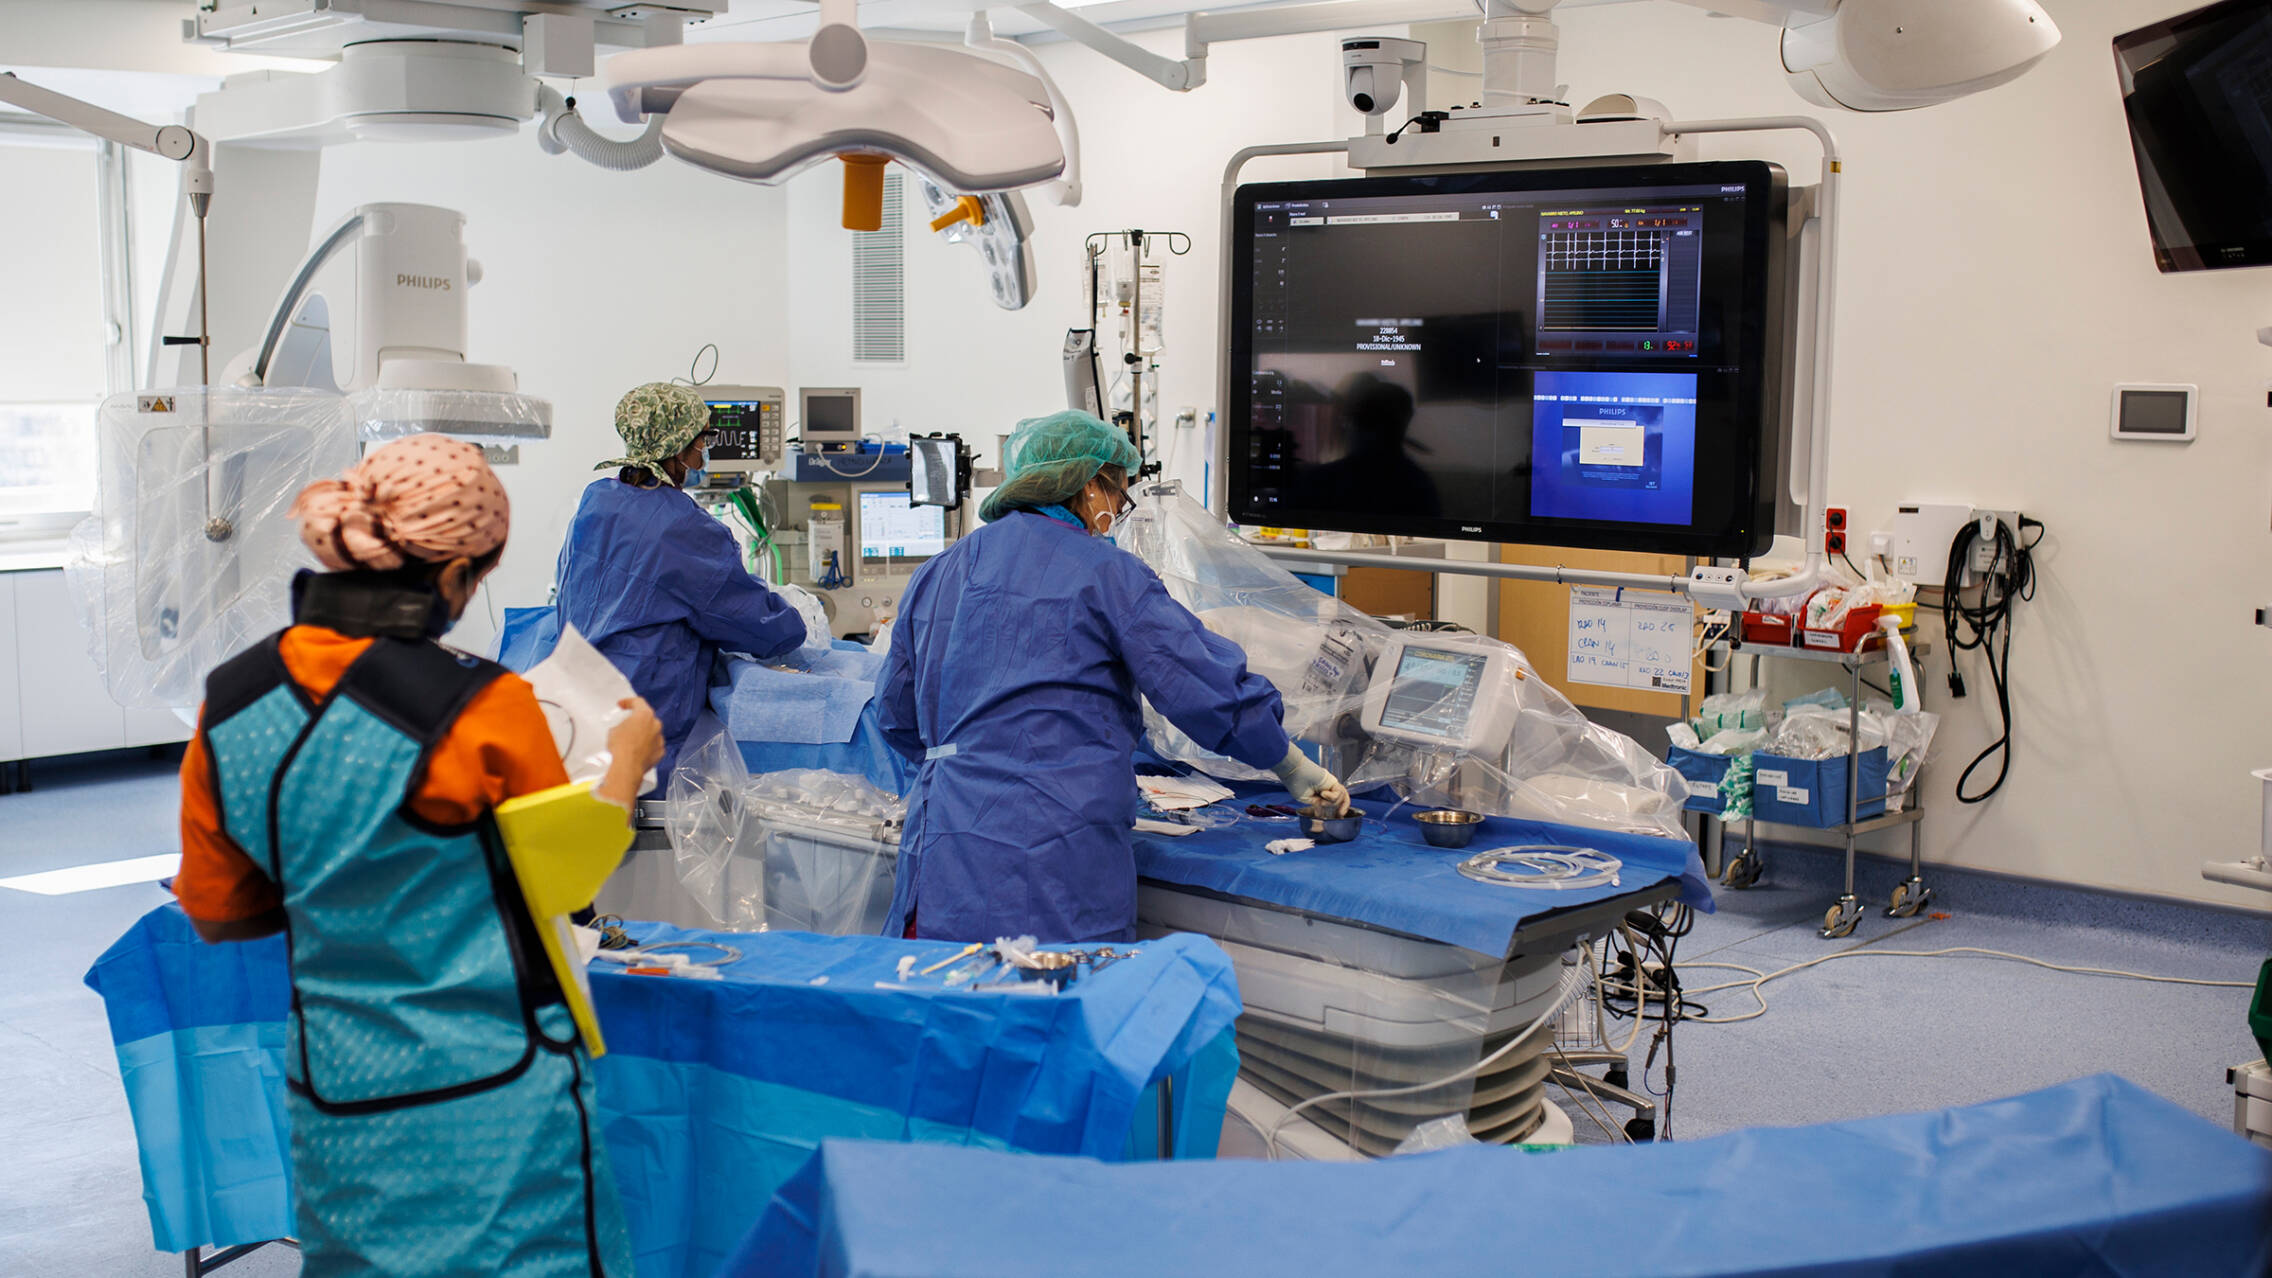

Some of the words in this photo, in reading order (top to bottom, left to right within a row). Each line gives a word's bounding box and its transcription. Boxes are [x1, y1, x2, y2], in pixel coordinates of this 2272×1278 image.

[1720, 185, 1745, 193] PHILIPS
[396, 273, 452, 291] PHILIPS
[1356, 343, 1422, 351] PROVISIONAL/UNKNOWN
[1599, 408, 1627, 416] PHILIPS
